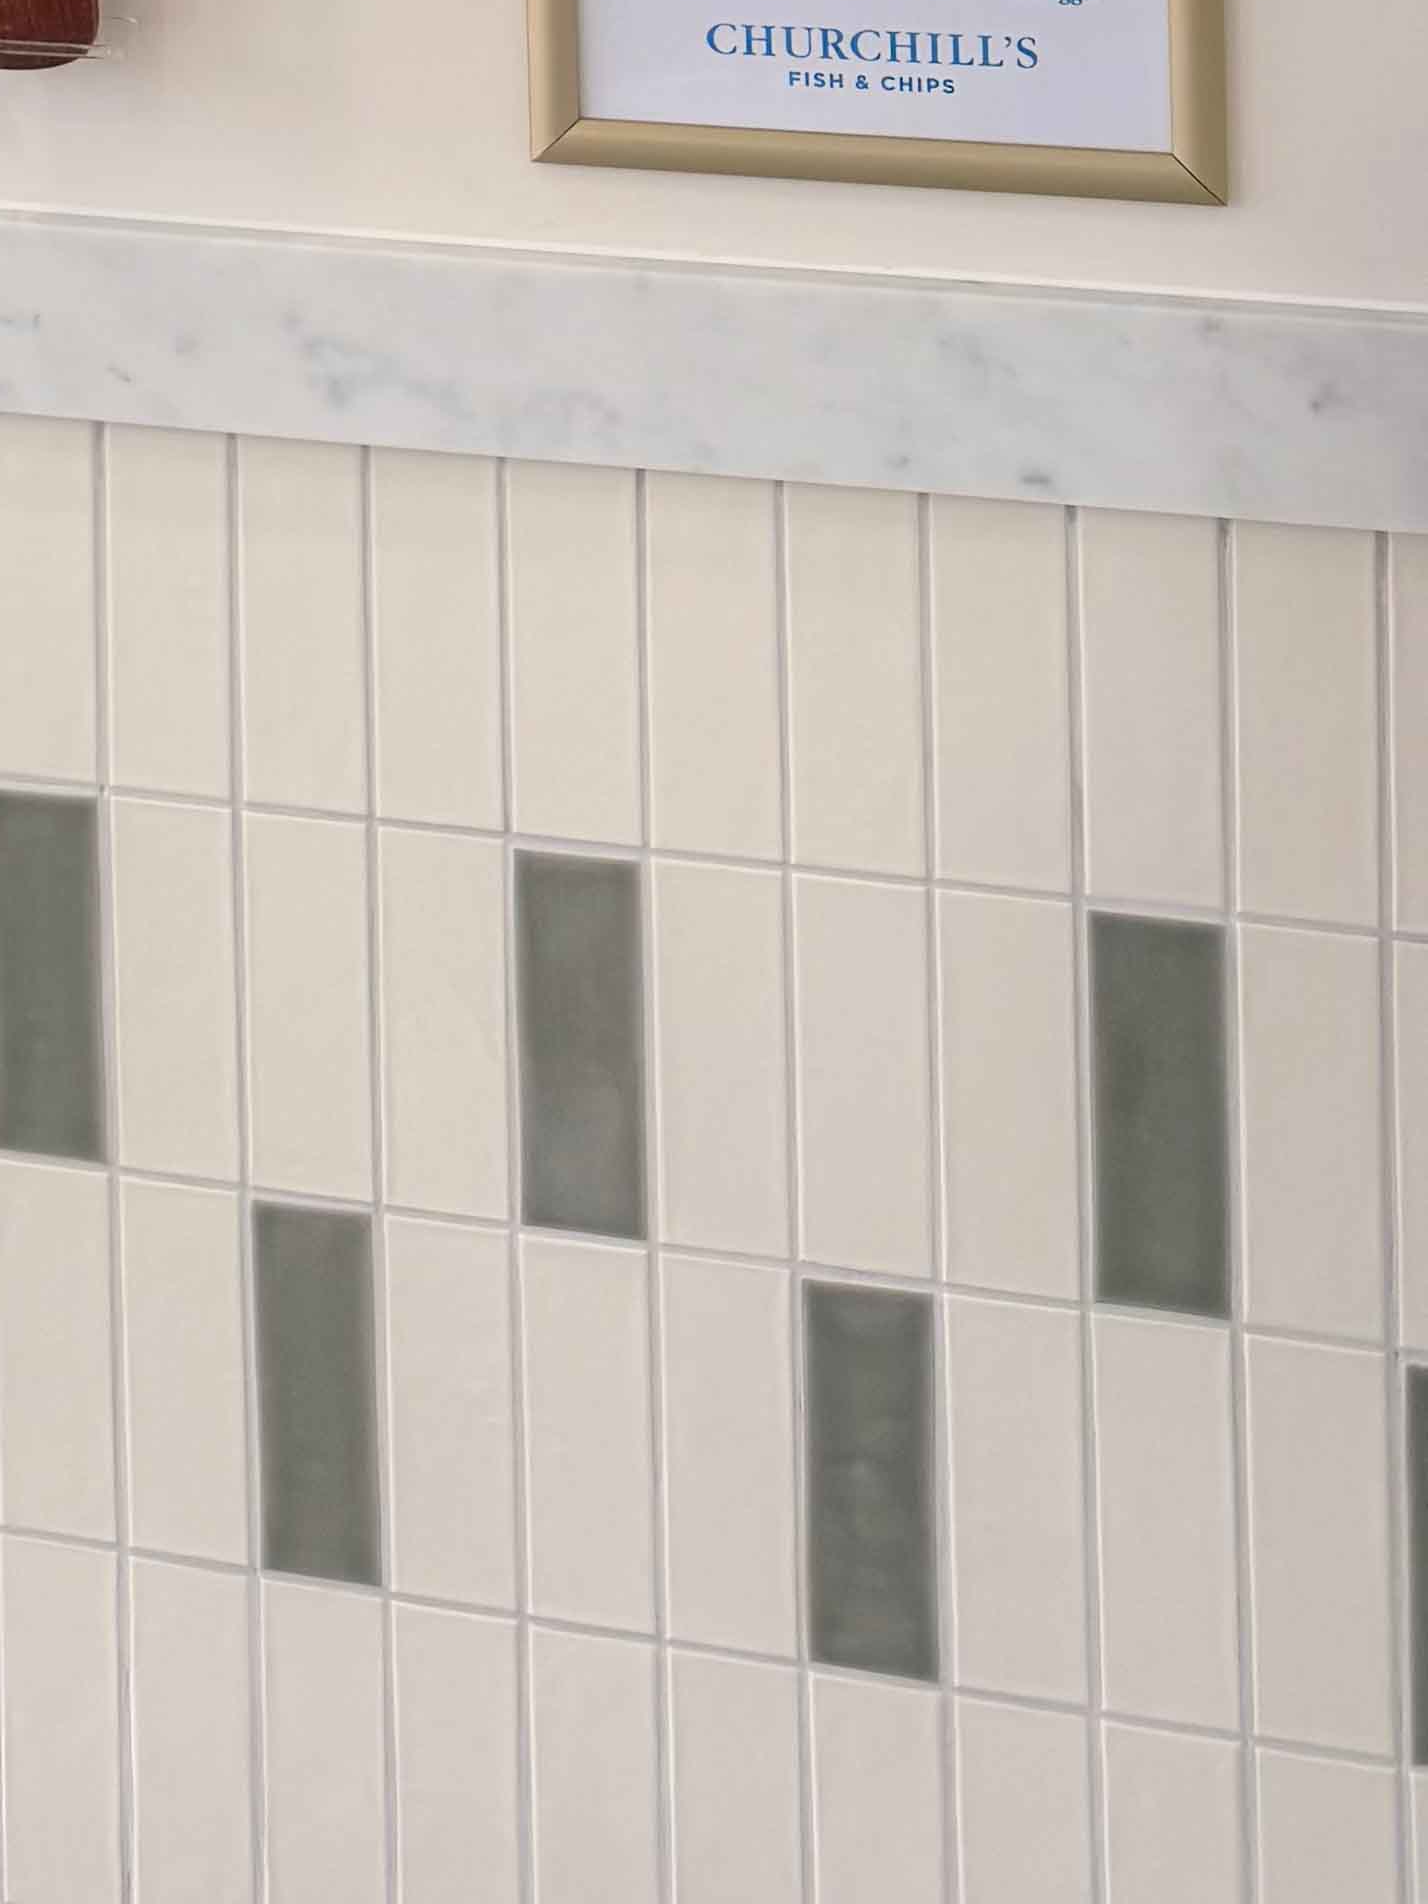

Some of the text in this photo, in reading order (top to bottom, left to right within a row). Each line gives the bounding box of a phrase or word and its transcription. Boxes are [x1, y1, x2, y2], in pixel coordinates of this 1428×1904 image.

[706, 23, 1039, 70] CHURCHILL'S
[788, 70, 955, 95] FISH & CHIPS
